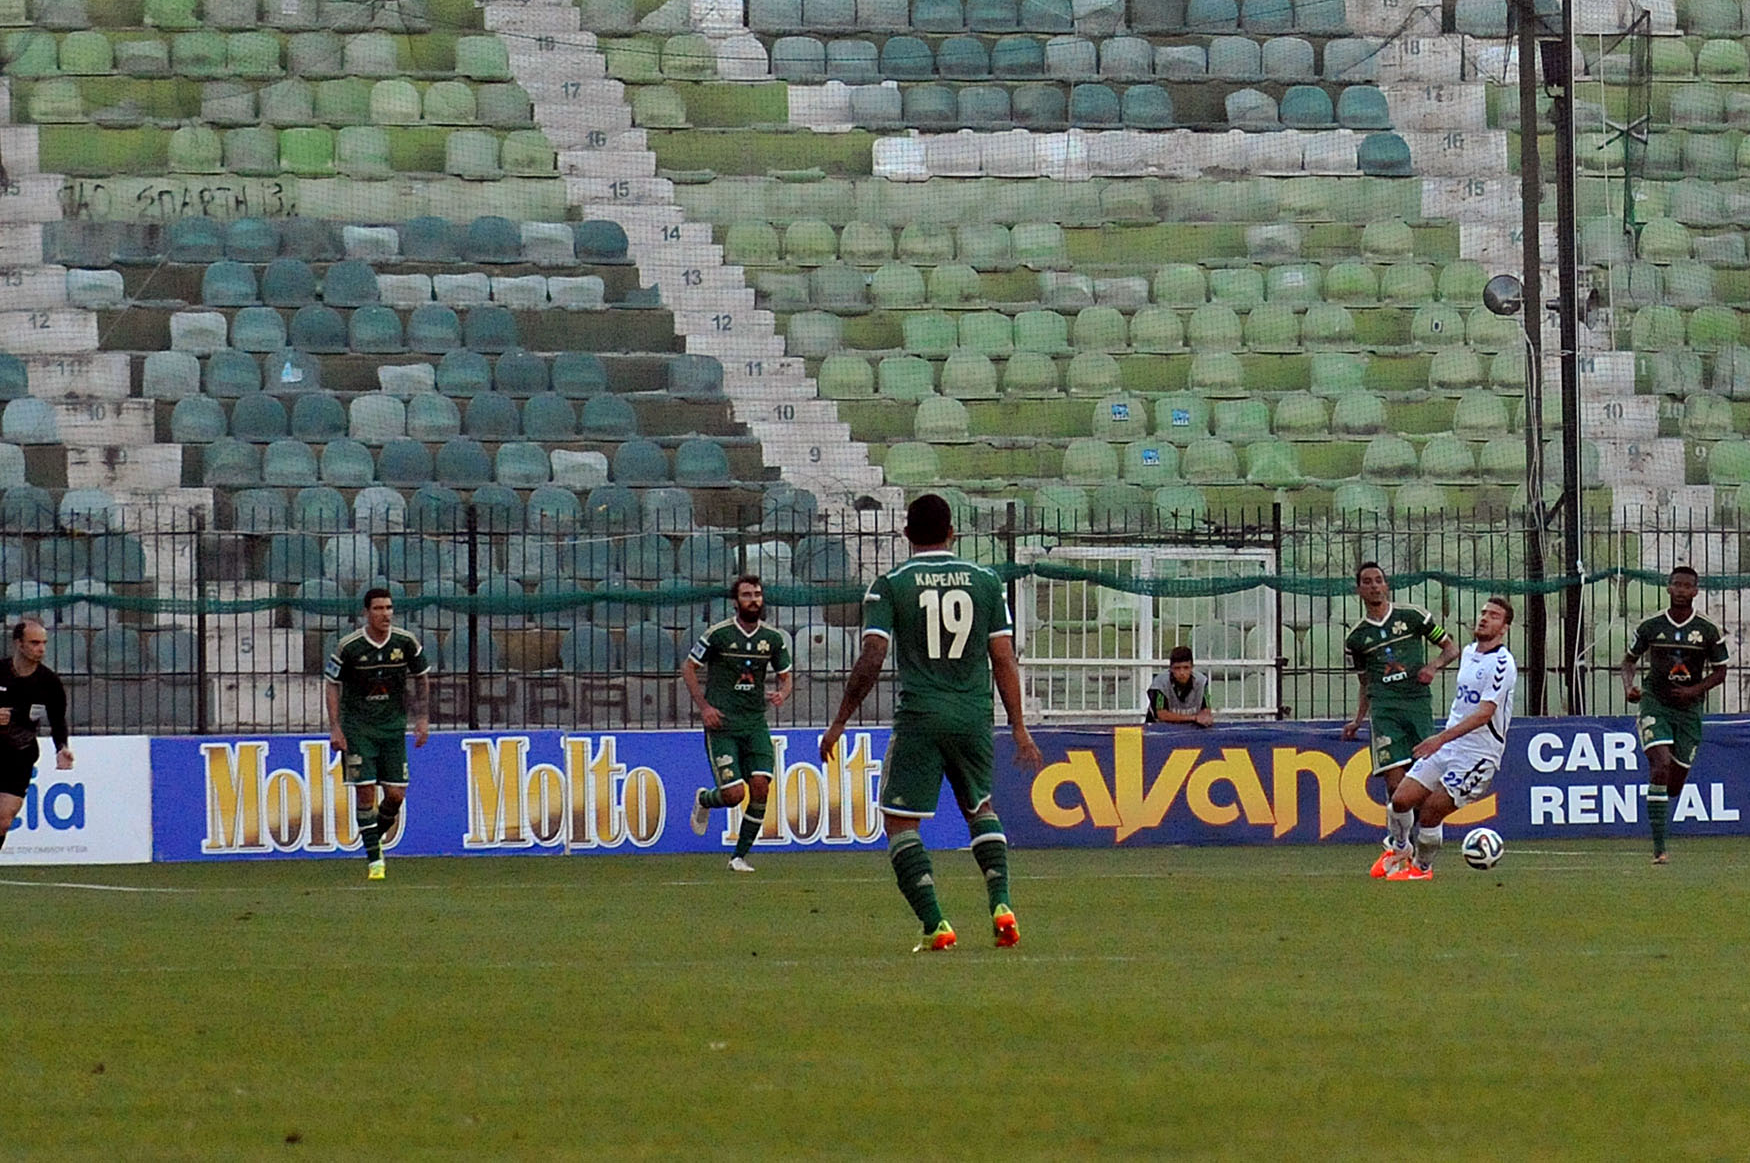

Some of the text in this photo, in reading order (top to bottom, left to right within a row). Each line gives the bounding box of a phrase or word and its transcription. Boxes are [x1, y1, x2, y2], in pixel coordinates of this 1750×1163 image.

[561, 82, 582, 99] 17
[585, 130, 607, 148] 16
[609, 181, 630, 199] 15
[1464, 178, 1486, 197] 15
[660, 225, 682, 242] 14
[681, 269, 702, 286] 13
[29, 312, 51, 329] 12
[711, 314, 733, 332] 12
[745, 360, 764, 377] 11
[773, 404, 795, 421] 10
[1603, 402, 1624, 420] 10
[809, 446, 821, 464] 9
[1695, 446, 1707, 462] 9
[915, 571, 973, 587] ΚΑΡΕΛΗΣ
[918, 588, 974, 660] 19
[241, 637, 254, 654] 5
[1527, 732, 1638, 774] CAR
[461, 735, 667, 849] Molto
[722, 736, 887, 849] olt
[1031, 726, 1498, 843] avanc
[7, 766, 86, 831] ia
[1530, 782, 1741, 826] RENAL
